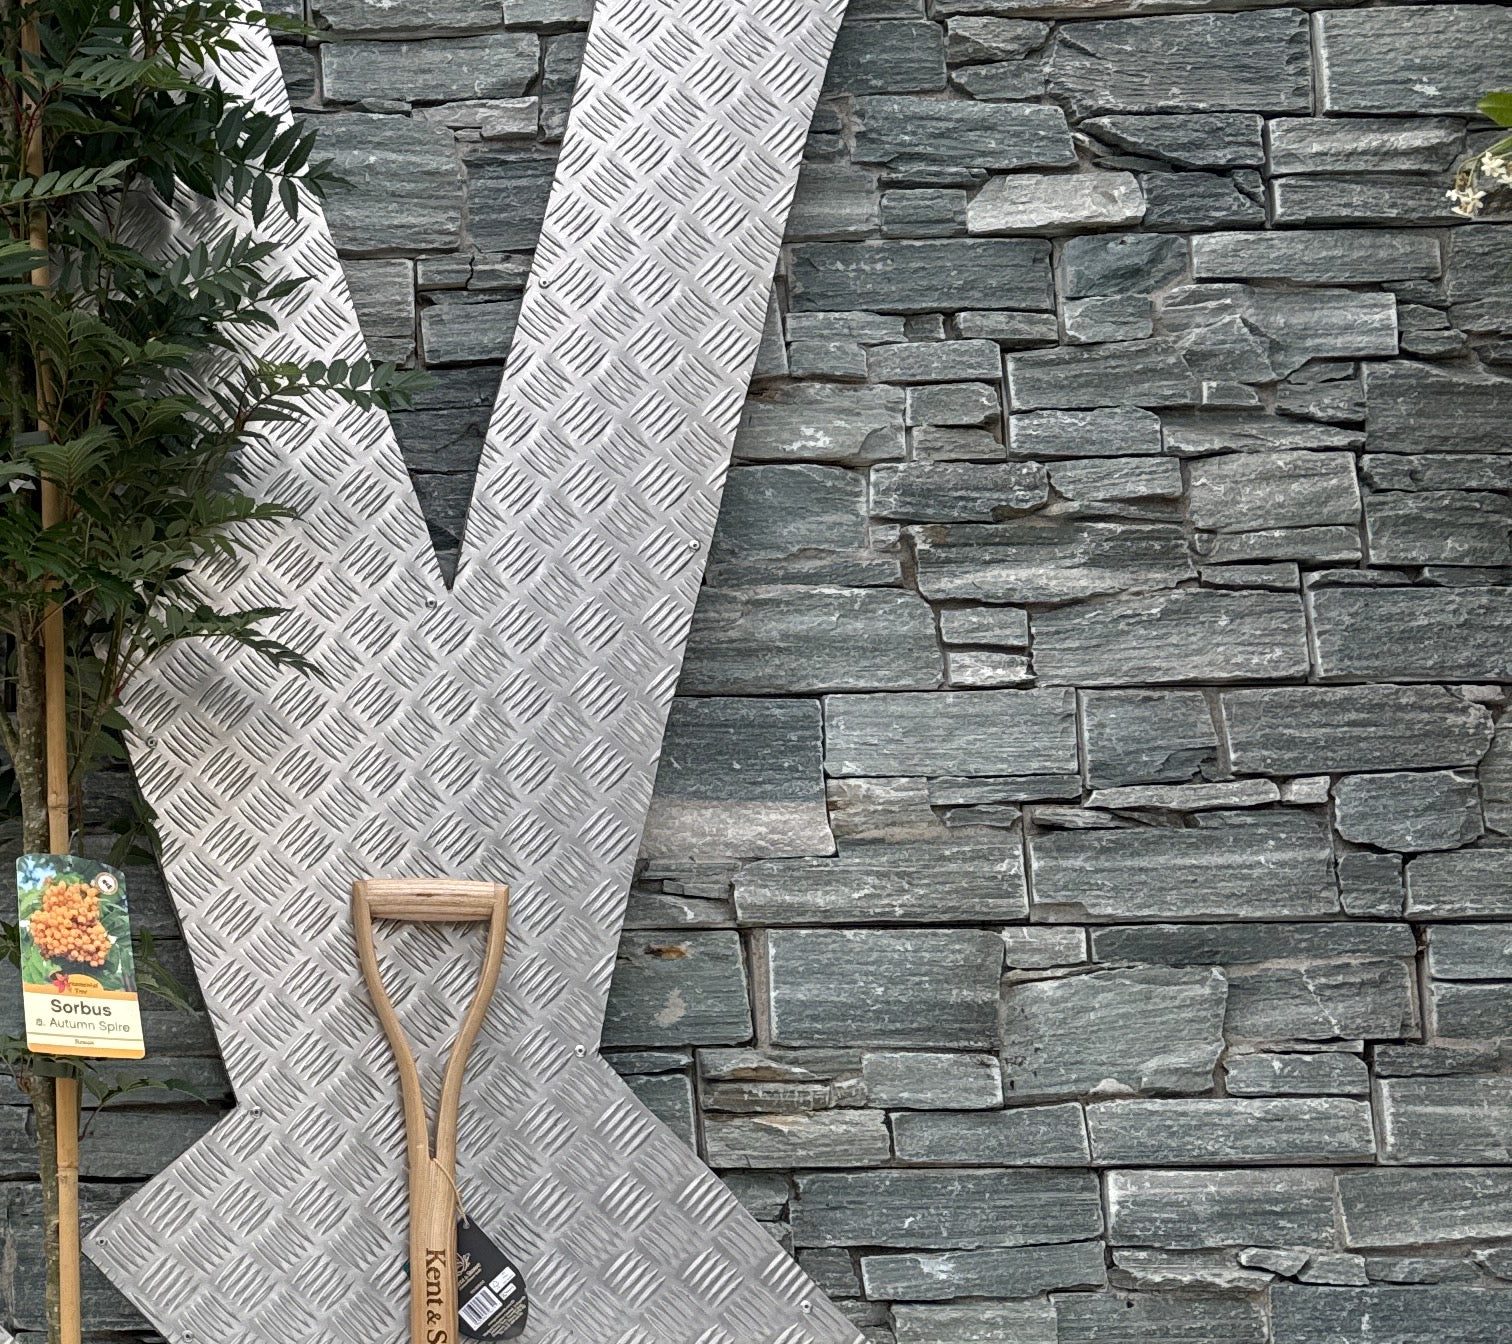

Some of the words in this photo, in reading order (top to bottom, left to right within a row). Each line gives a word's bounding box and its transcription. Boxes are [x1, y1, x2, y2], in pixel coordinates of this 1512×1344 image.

[50, 998, 112, 1017] Sorbus
[49, 1017, 96, 1031] Autumn
[99, 1019, 131, 1033] Spire
[425, 1247, 446, 1307] Kent
[426, 1309, 441, 1325] &
